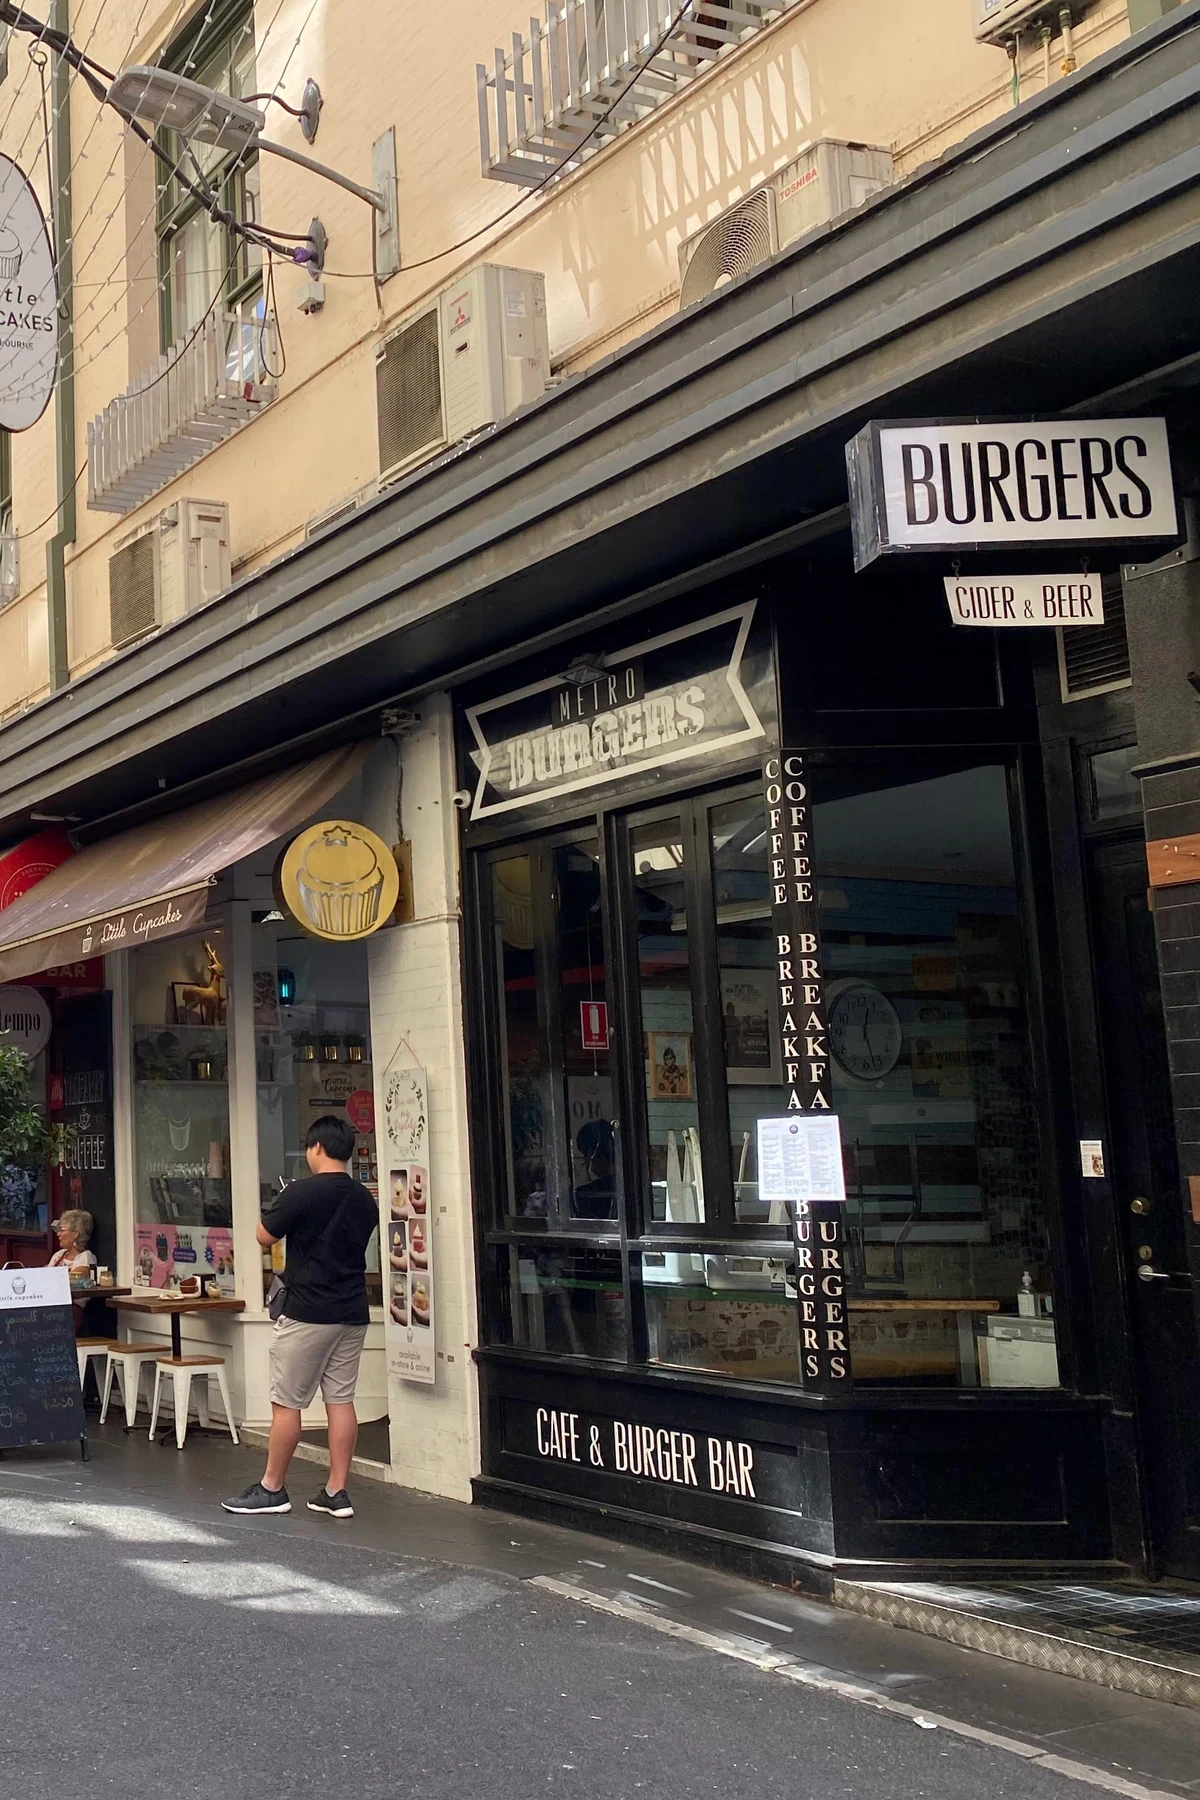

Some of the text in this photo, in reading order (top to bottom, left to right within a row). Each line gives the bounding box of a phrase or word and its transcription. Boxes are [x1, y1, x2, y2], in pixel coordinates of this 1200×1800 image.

[780, 168, 817, 200] TOSHIBA
[901, 435, 1152, 526] BURGERS
[955, 584, 1094, 619] CIDER & BEER
[507, 685, 706, 790] BURGERS
[560, 667, 635, 722] METRO
[765, 758, 788, 905] COFFEE
[784, 756, 813, 902] COFFEE
[101, 903, 183, 943] Little Cupcakes
[776, 934, 803, 1110] BREAKFA
[798, 933, 830, 1109] BREAKFA
[64, 1134, 106, 1169] COFFEE
[795, 1200, 819, 1377] BURGERS
[818, 1221, 847, 1378] URGERS
[536, 1407, 756, 1498] CAFE & BURGER BAR
